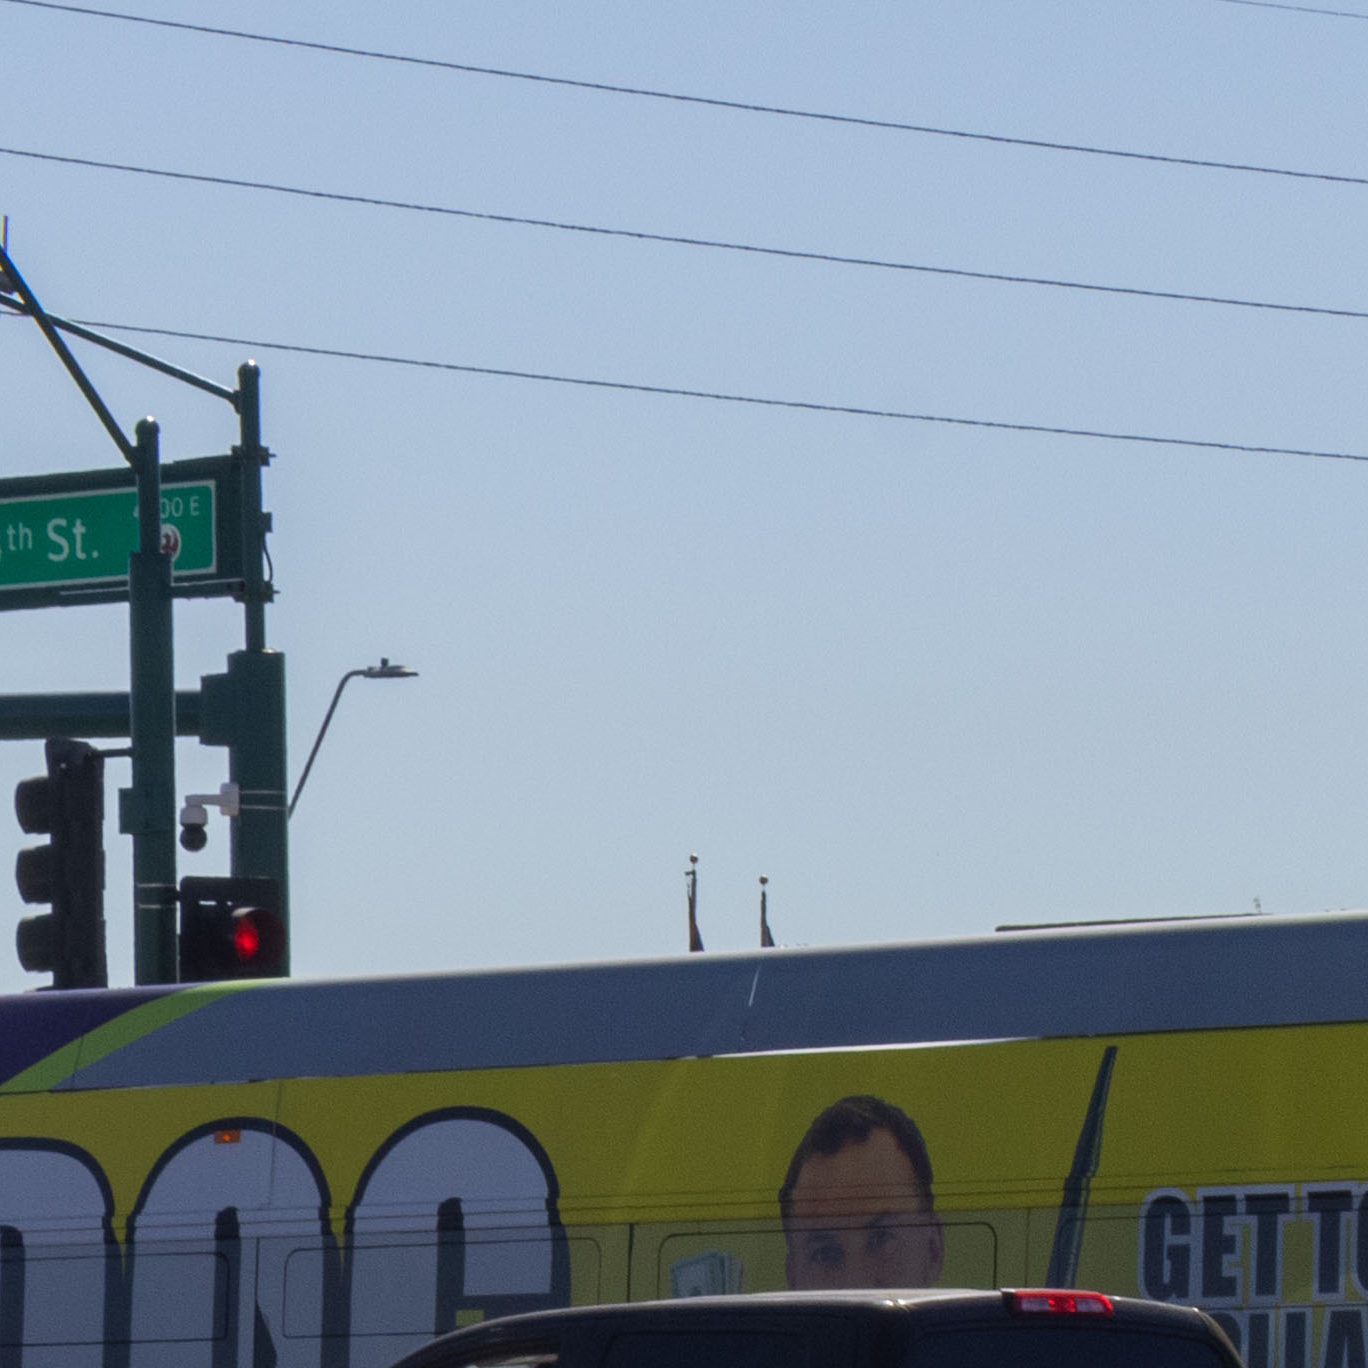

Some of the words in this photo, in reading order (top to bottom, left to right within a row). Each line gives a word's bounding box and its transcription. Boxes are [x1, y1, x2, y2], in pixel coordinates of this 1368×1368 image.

[133, 497, 183, 518] 00
[190, 496, 200, 516] E
[46, 518, 99, 562] St.
[1139, 1184, 1295, 1302] GET
